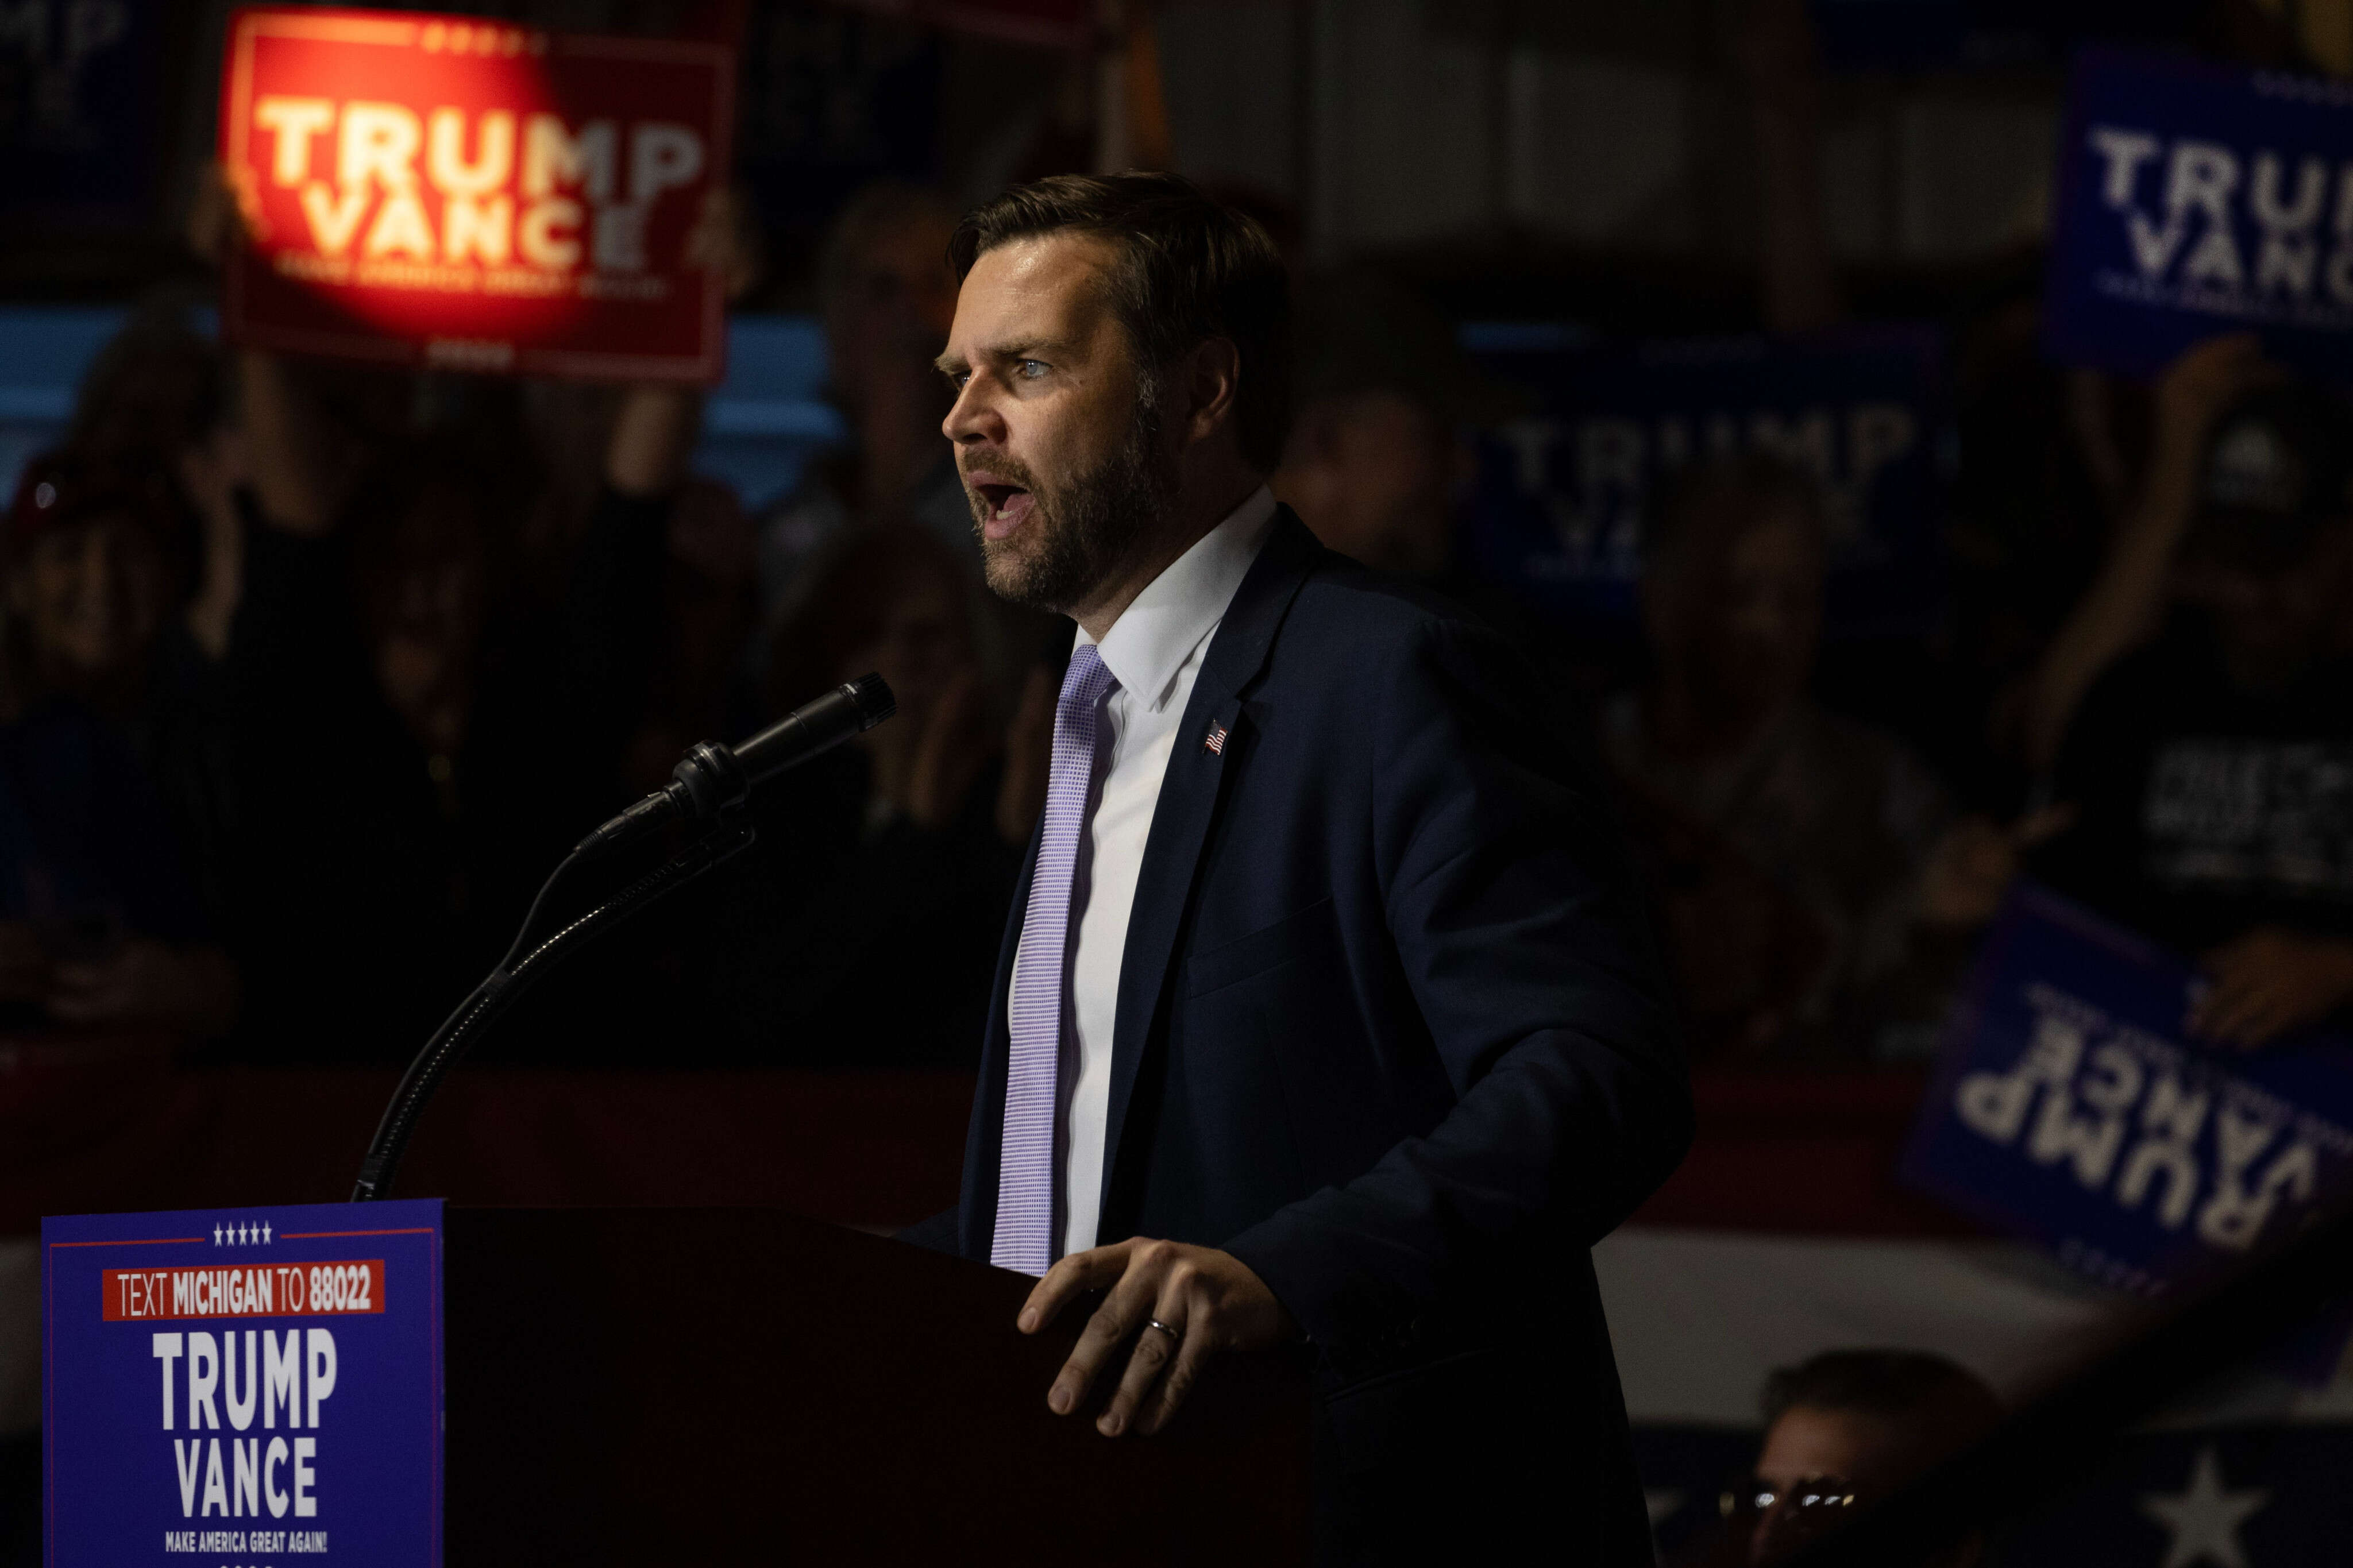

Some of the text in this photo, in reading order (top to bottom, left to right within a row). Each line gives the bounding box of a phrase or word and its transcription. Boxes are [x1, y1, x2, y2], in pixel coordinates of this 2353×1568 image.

[254, 95, 705, 202] TRUMP
[2085, 122, 2353, 230] TRU
[299, 179, 648, 275] VANCE
[1954, 1069, 2276, 1252] RUMP
[2032, 1018, 2318, 1204] VANCE
[118, 1264, 371, 1316] TEXT MICHIGAN TO 88022
[153, 1328, 338, 1431] TRUMP
[174, 1436, 318, 1518] VANCE
[165, 1531, 328, 1552] MAKE AMERICA GREAT AGAIN!
